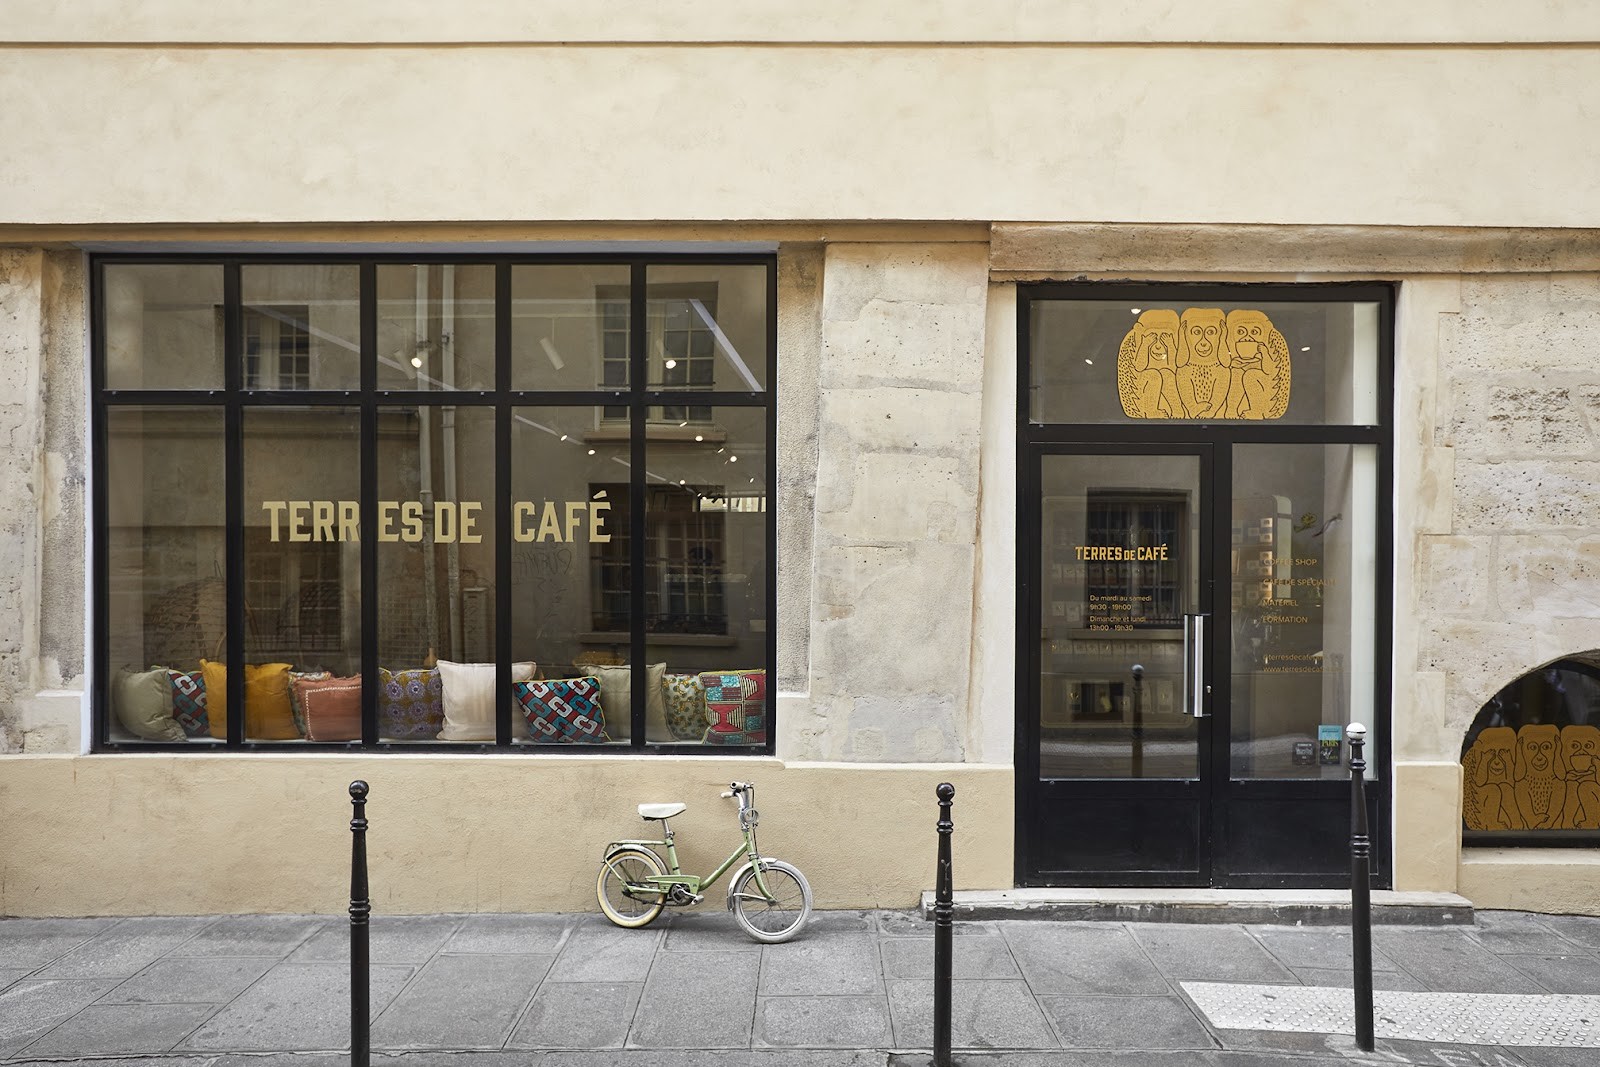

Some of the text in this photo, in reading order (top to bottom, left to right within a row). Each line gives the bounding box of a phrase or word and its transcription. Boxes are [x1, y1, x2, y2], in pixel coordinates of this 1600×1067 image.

[262, 490, 611, 543] TERRES DE CAFÉ
[1075, 543, 1168, 560] TERRES DE CAFÉ
